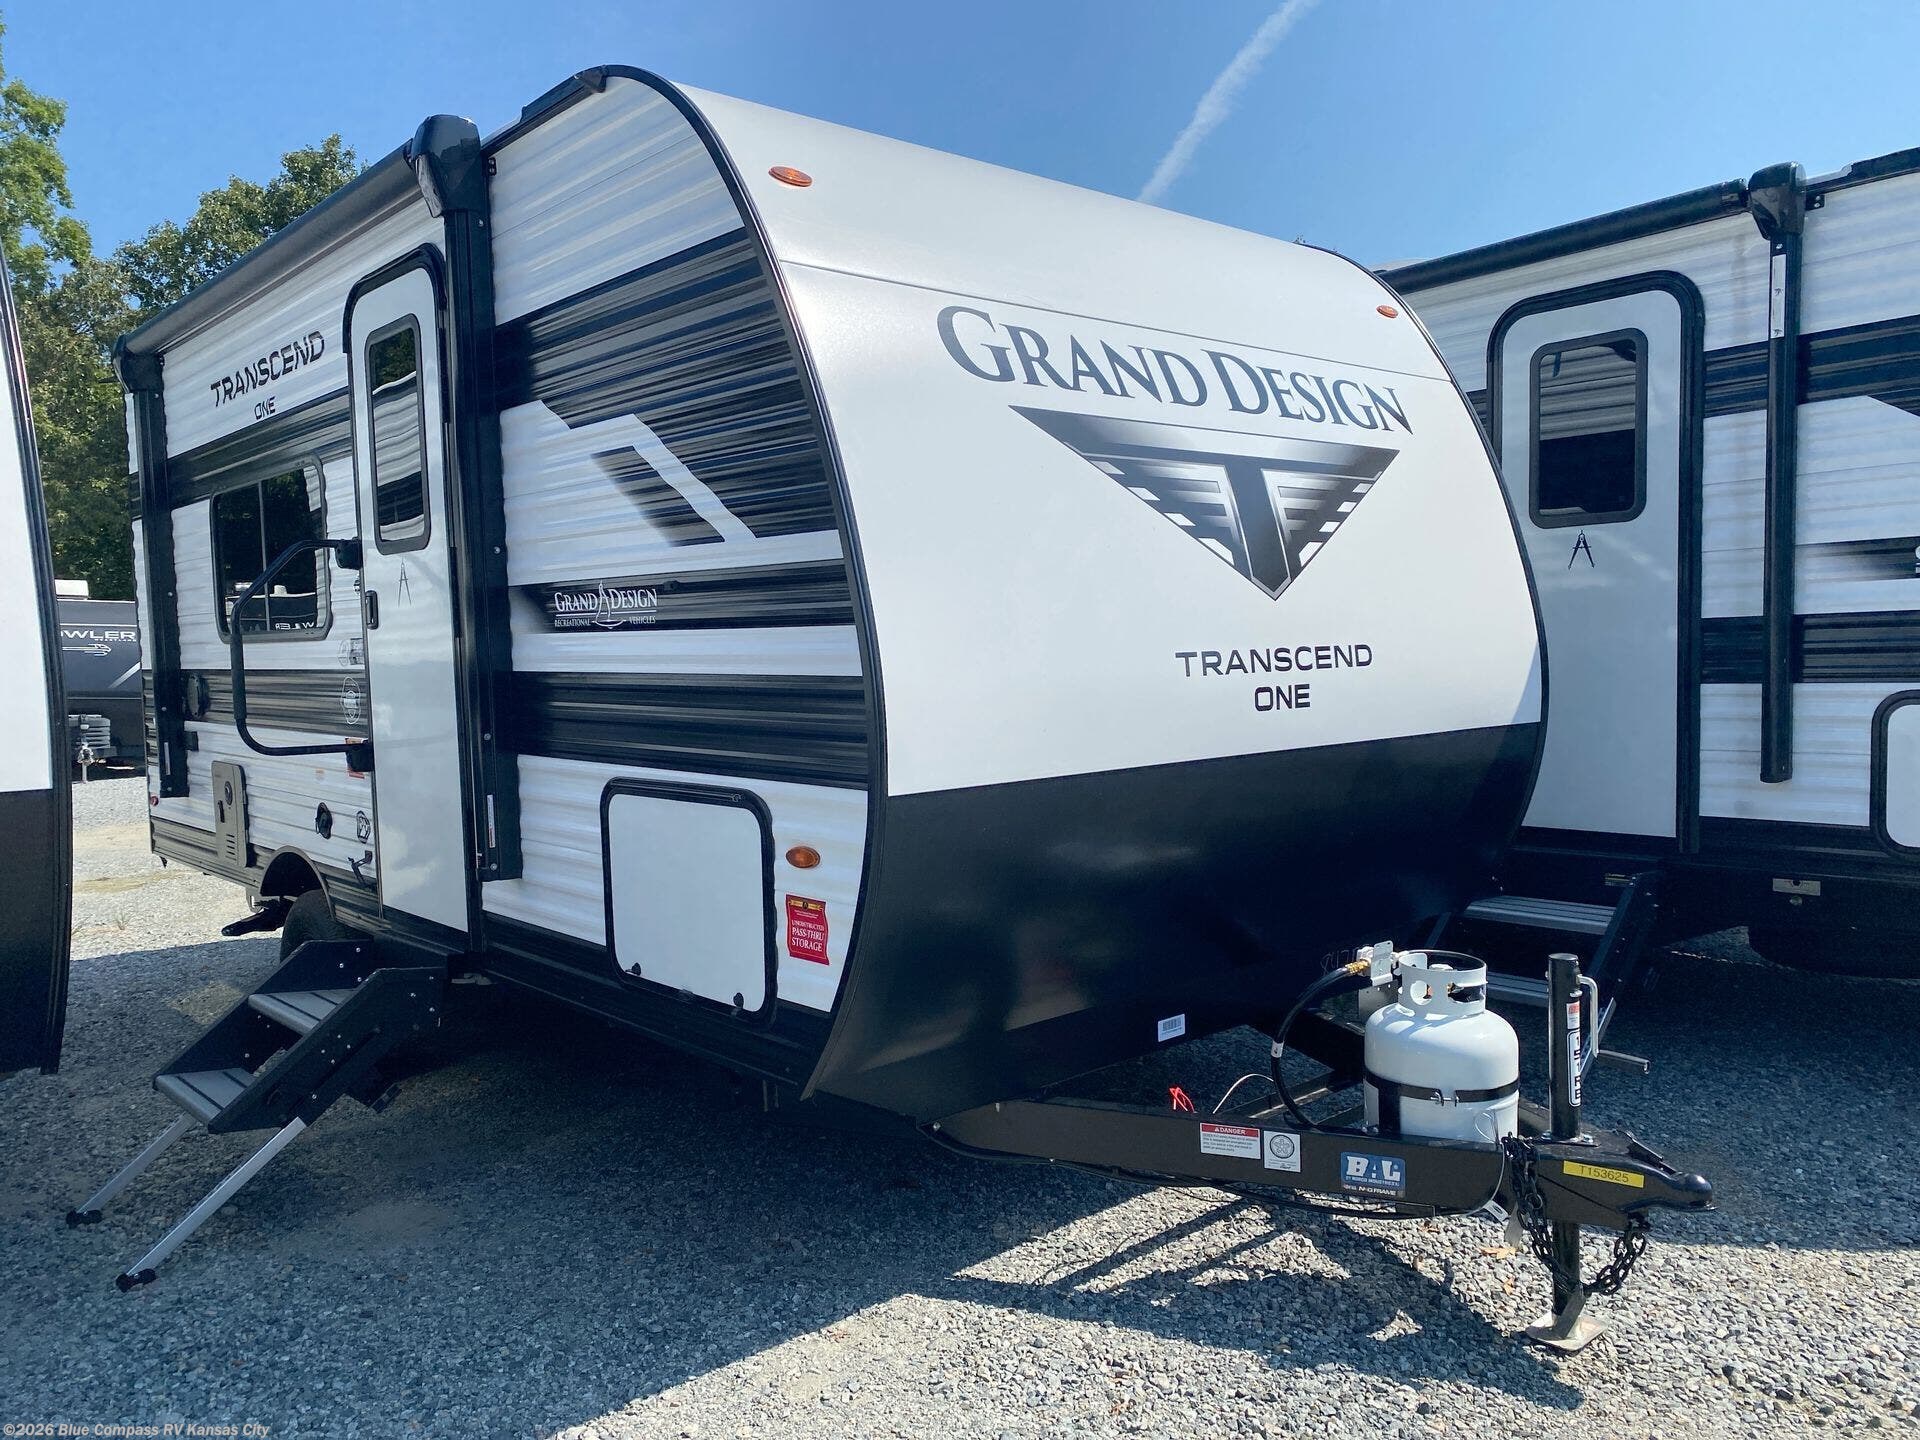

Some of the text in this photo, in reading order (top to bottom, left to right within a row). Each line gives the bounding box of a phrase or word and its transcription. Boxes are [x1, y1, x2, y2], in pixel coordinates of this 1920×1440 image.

[210, 330, 325, 408] TRANSCEND
[936, 305, 1414, 435] GRAND DESIGN
[254, 396, 276, 420] ONE
[554, 588, 658, 612] GRAND DESIGN
[554, 615, 656, 628] RECREATIONAL VEHICLES
[60, 629, 137, 640] WLER
[1175, 644, 1373, 678] TRANSCEND
[1254, 683, 1311, 712] ONE
[791, 926, 825, 941] PASS-THRU
[791, 936, 823, 952] STORAGE
[1220, 1127, 1247, 1136] DANGER
[1578, 1164, 1630, 1183] T153625
